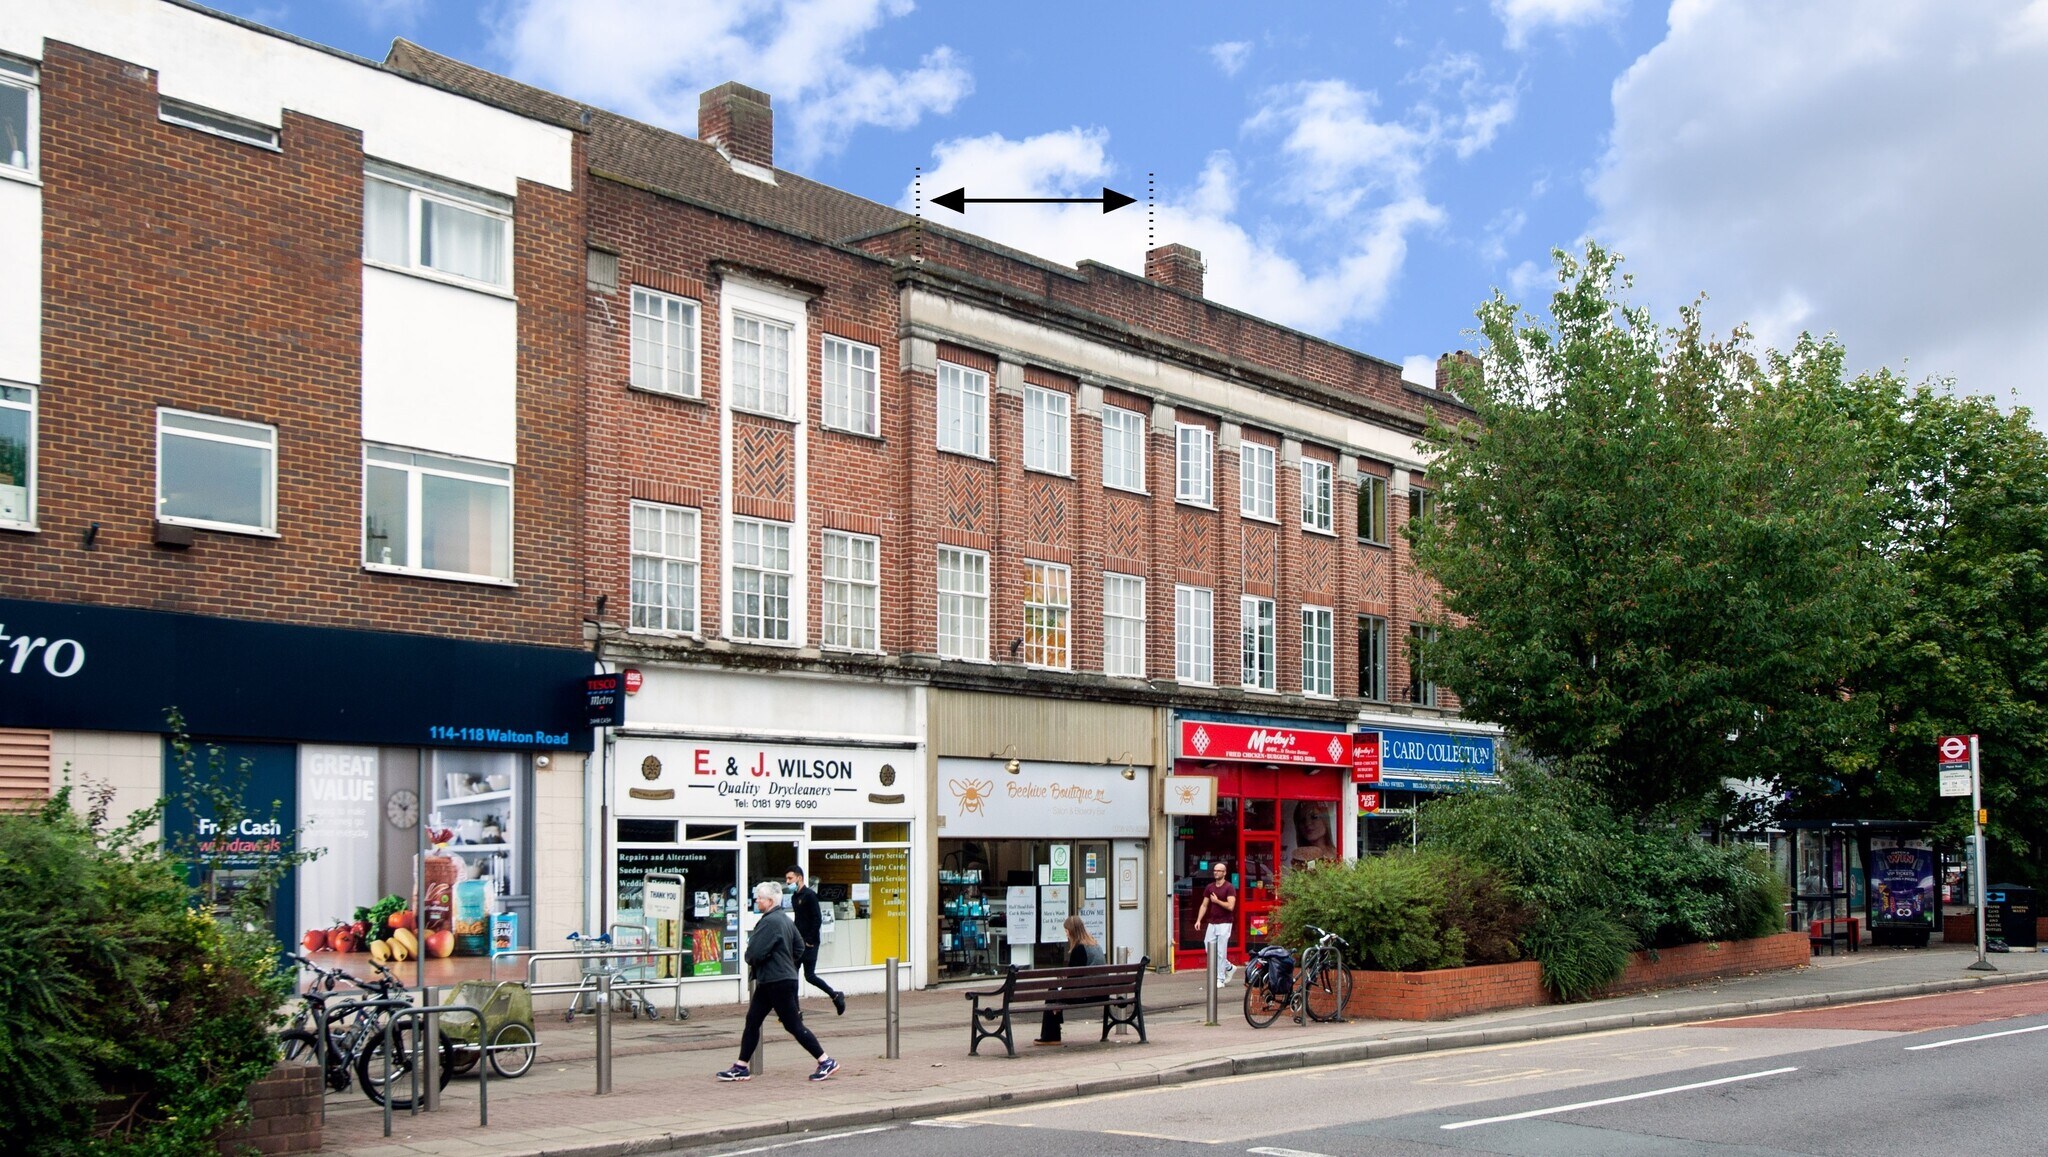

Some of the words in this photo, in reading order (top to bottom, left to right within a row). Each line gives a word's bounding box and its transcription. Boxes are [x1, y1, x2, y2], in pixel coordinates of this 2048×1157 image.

[588, 679, 616, 690] TESCO
[590, 696, 614, 705] Metro
[430, 726, 485, 741] 114-118
[486, 729, 533, 743] Walton
[536, 731, 569, 744] Road
[1247, 729, 1296, 753] Morley's
[1393, 740, 1424, 760] CARD
[1427, 743, 1490, 765] COLLECTION
[311, 753, 374, 777] GREAT
[694, 749, 716, 775] E.
[725, 756, 738, 776] &
[751, 752, 770, 777] J.
[778, 758, 852, 779] WILSON
[310, 778, 374, 801] VALUE
[718, 780, 761, 797] Quality
[768, 781, 832, 797] Drycleaners
[1006, 780, 1047, 798] Beehive
[1050, 782, 1093, 804] Boutique
[734, 798, 749, 808] Tel:
[752, 799, 771, 808] 0181
[775, 799, 791, 808] 979
[795, 799, 817, 809] 6090
[1361, 794, 1376, 802] JUST
[199, 818, 237, 835] Fre
[240, 818, 281, 835] Cash
[619, 853, 649, 862] Repairs
[666, 853, 707, 861] Alterations
[825, 852, 854, 860] Collection
[862, 852, 885, 860] Delivery
[1886, 853, 1915, 864] WIN
[619, 866, 643, 874] Suedes
[659, 866, 689, 874] Leathers
[619, 892, 636, 900] Gold
[650, 891, 665, 899] THANK
[666, 892, 677, 900] YOU
